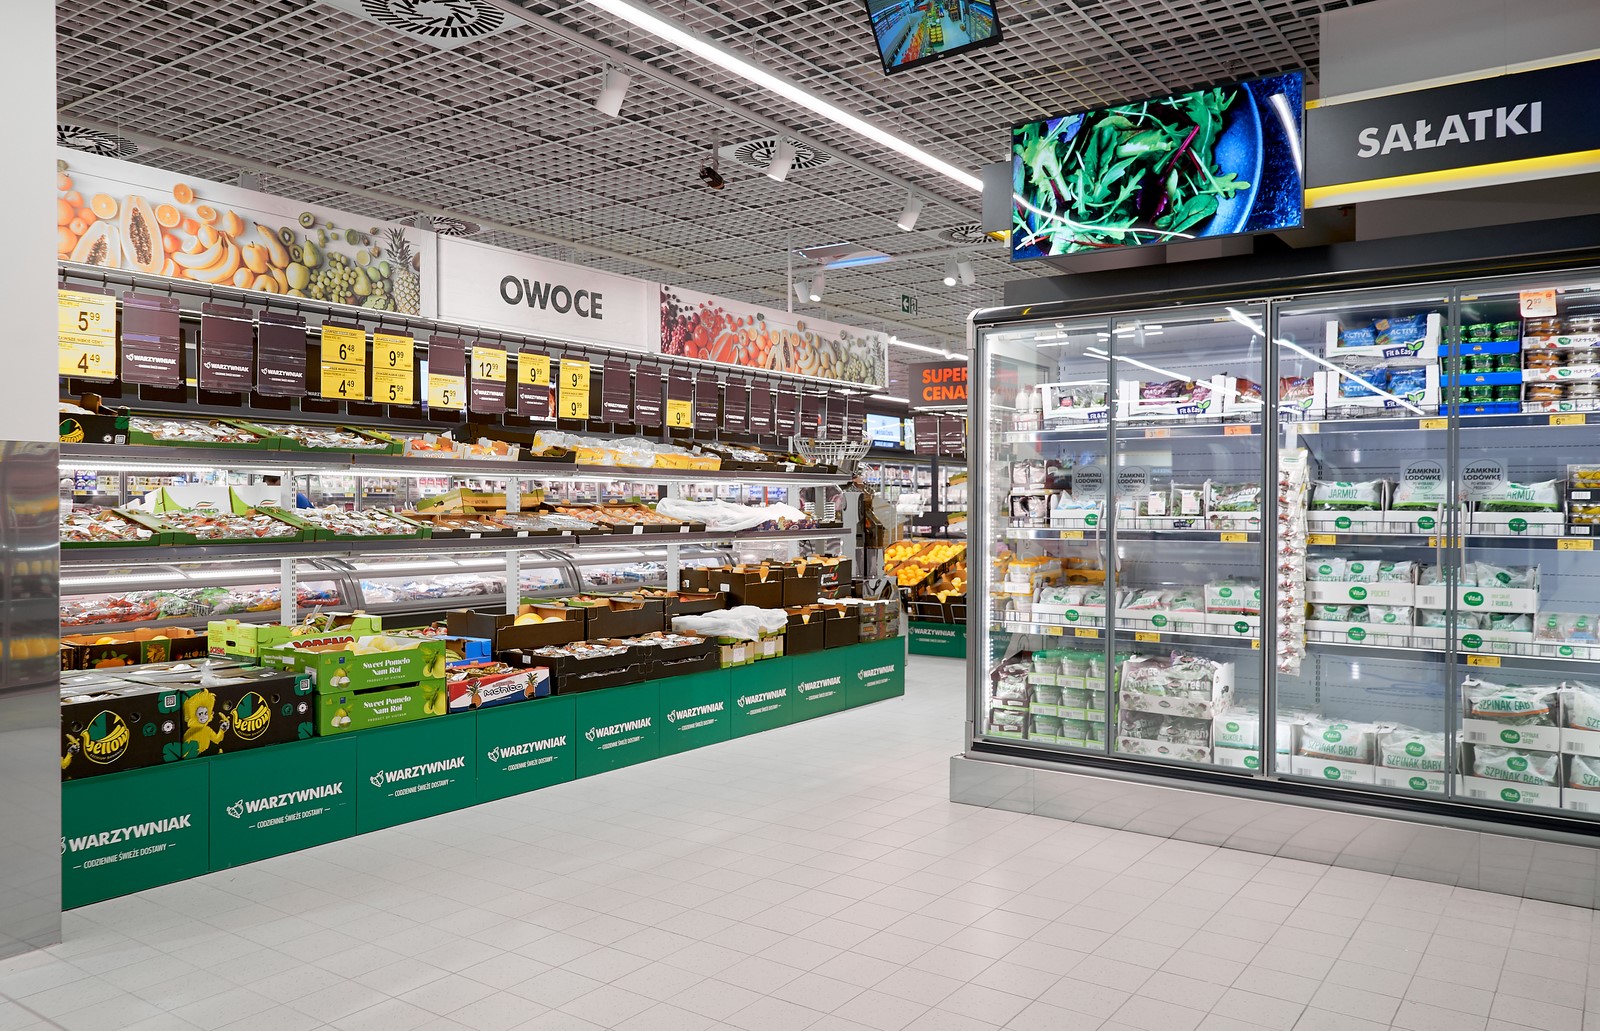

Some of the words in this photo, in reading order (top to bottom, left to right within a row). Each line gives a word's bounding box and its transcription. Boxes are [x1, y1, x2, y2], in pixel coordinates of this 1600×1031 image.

[1356, 101, 1543, 159] SAŁATKI
[499, 274, 603, 320] OWOCE
[1526, 299, 1534, 310] 2
[78, 311, 89, 331] 5
[89, 312, 101, 321] 99
[1390, 327, 1418, 335] ACTIVE
[339, 343, 347, 361] 6
[347, 344, 355, 352] 48
[389, 350, 397, 367] 9
[396, 351, 405, 359] 99
[1385, 349, 1395, 357] Fit
[1400, 348, 1415, 356] Easy
[77, 353, 89, 373] 4
[89, 354, 101, 363] 49
[211, 363, 249, 373] WARZYWNIAK
[479, 362, 493, 378] 12
[267, 369, 303, 378] WARZYWNIAK
[530, 367, 537, 382] 9
[572, 373, 578, 388] 9
[922, 367, 968, 385] SUPER
[338, 380, 347, 397] 4
[347, 380, 355, 388] 49
[389, 385, 397, 401] 5
[396, 385, 404, 393] 99
[442, 390, 450, 405] 5
[1386, 400, 1395, 408] Fit
[571, 402, 577, 416] 9
[1191, 406, 1204, 414] Easy
[676, 412, 682, 425] 9
[914, 627, 956, 637] WARZYWNIAK
[362, 659, 384, 670] Sweet
[384, 657, 411, 668] Pomelo
[389, 666, 401, 674] Roi
[863, 664, 895, 678] WARZYWNIAK
[804, 676, 841, 691] WARZYWNIAK
[363, 698, 385, 709] Sweet
[385, 695, 412, 706] Pomelo
[745, 688, 787, 705] WARZYWNIAK
[390, 705, 403, 713] Roi
[675, 701, 724, 720] WARZYWNIAK
[1478, 699, 1512, 711] SZPINAK
[595, 717, 652, 738] WARZYWNIAK
[500, 735, 567, 759] WARZYWNIAK
[1307, 739, 1336, 755] SZPINAK
[1338, 745, 1358, 756] BABY
[385, 756, 465, 783] WARZYWNIAK
[1386, 754, 1420, 768] SZPINAK
[1421, 760, 1442, 770] BABY
[1484, 766, 1520, 780] SZPINAK
[1523, 774, 1544, 785] BABY
[431, 779, 449, 789] DOSTAWY
[245, 782, 343, 814] WARZYWNIAK
[257, 816, 284, 829] CODZIENNIE
[284, 811, 302, 822] ŚWIEŻE
[301, 807, 324, 819] DOSTAWY
[68, 814, 191, 853] WARZYWNIAK
[83, 854, 118, 869] CODZIENNIE
[118, 848, 139, 861] ŚWIEŻE
[139, 843, 167, 856] DOSTAWY
